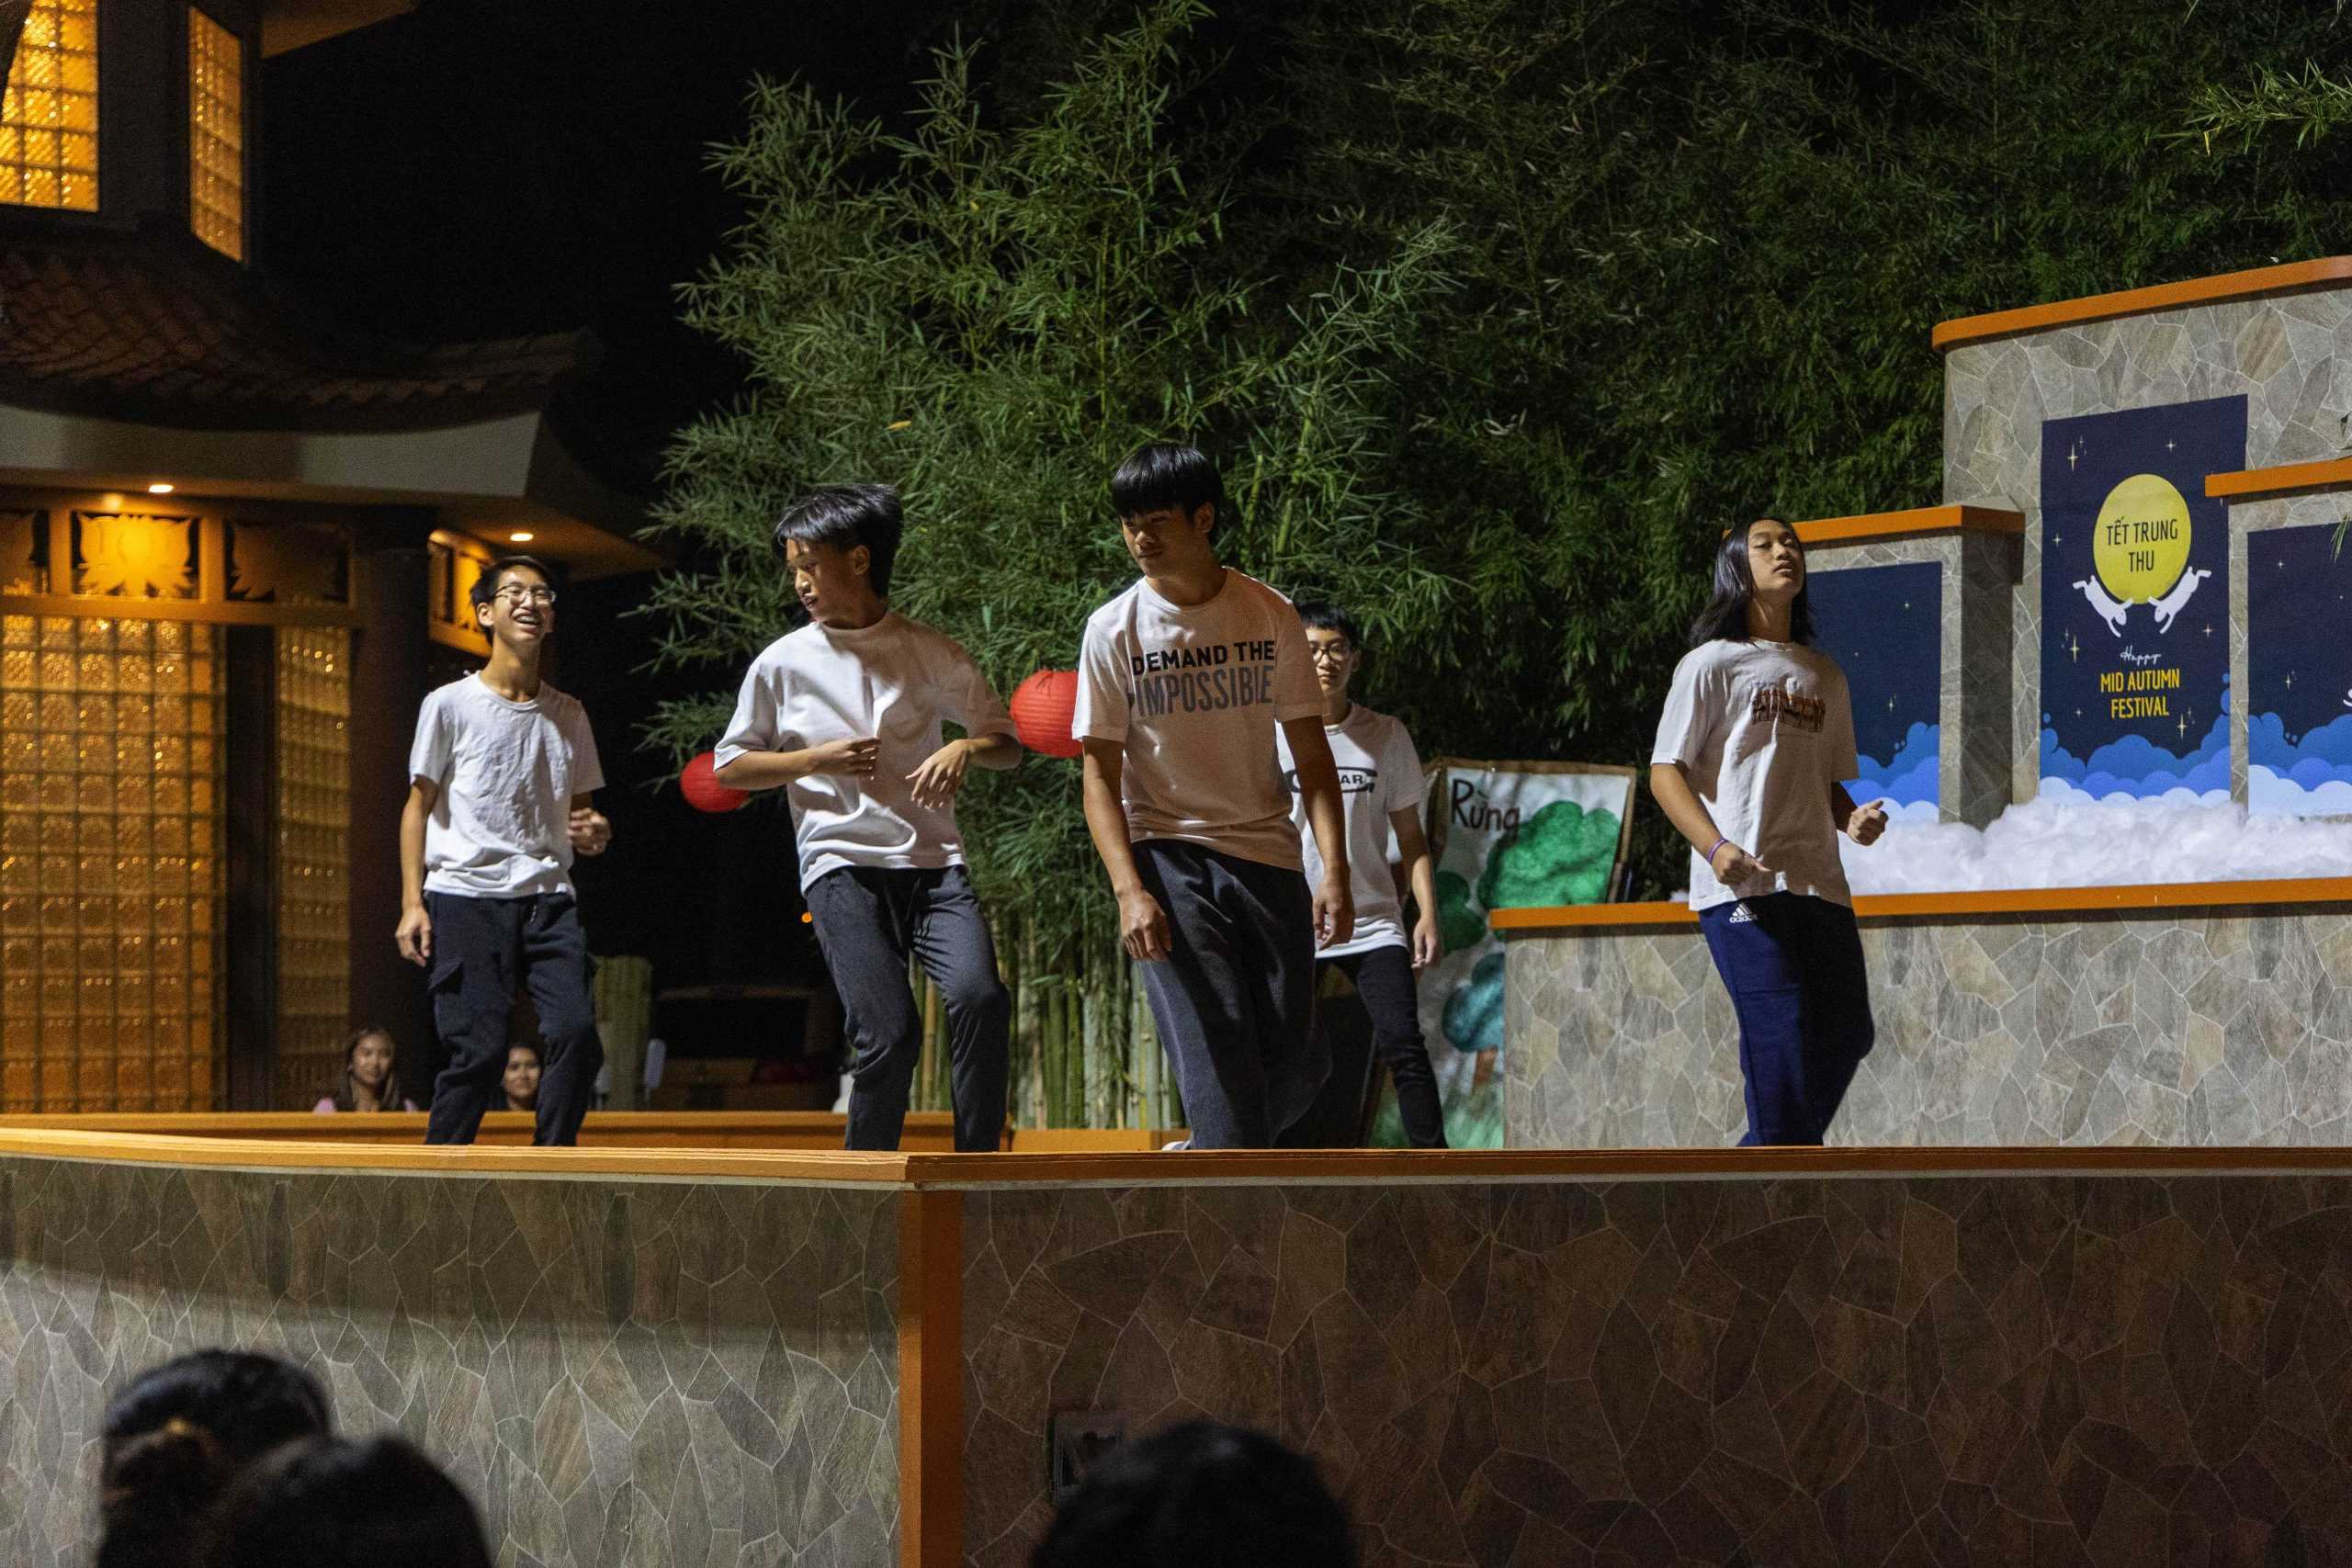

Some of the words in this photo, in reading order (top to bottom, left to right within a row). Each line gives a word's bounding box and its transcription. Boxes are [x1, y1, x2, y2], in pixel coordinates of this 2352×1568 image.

[2107, 516, 2130, 546] TẾT
[2133, 519, 2178, 543] TRUNG
[2129, 550, 2154, 572] THU
[1132, 645, 1228, 676] DEMAND
[1234, 640, 1275, 661] THE
[2120, 645, 2162, 666] Happy
[1135, 665, 1274, 716] IMPOSSIBLE
[2100, 671, 2124, 693] MID
[2127, 668, 2180, 691] AUTUMN
[2111, 696, 2170, 719] FESTIVAL
